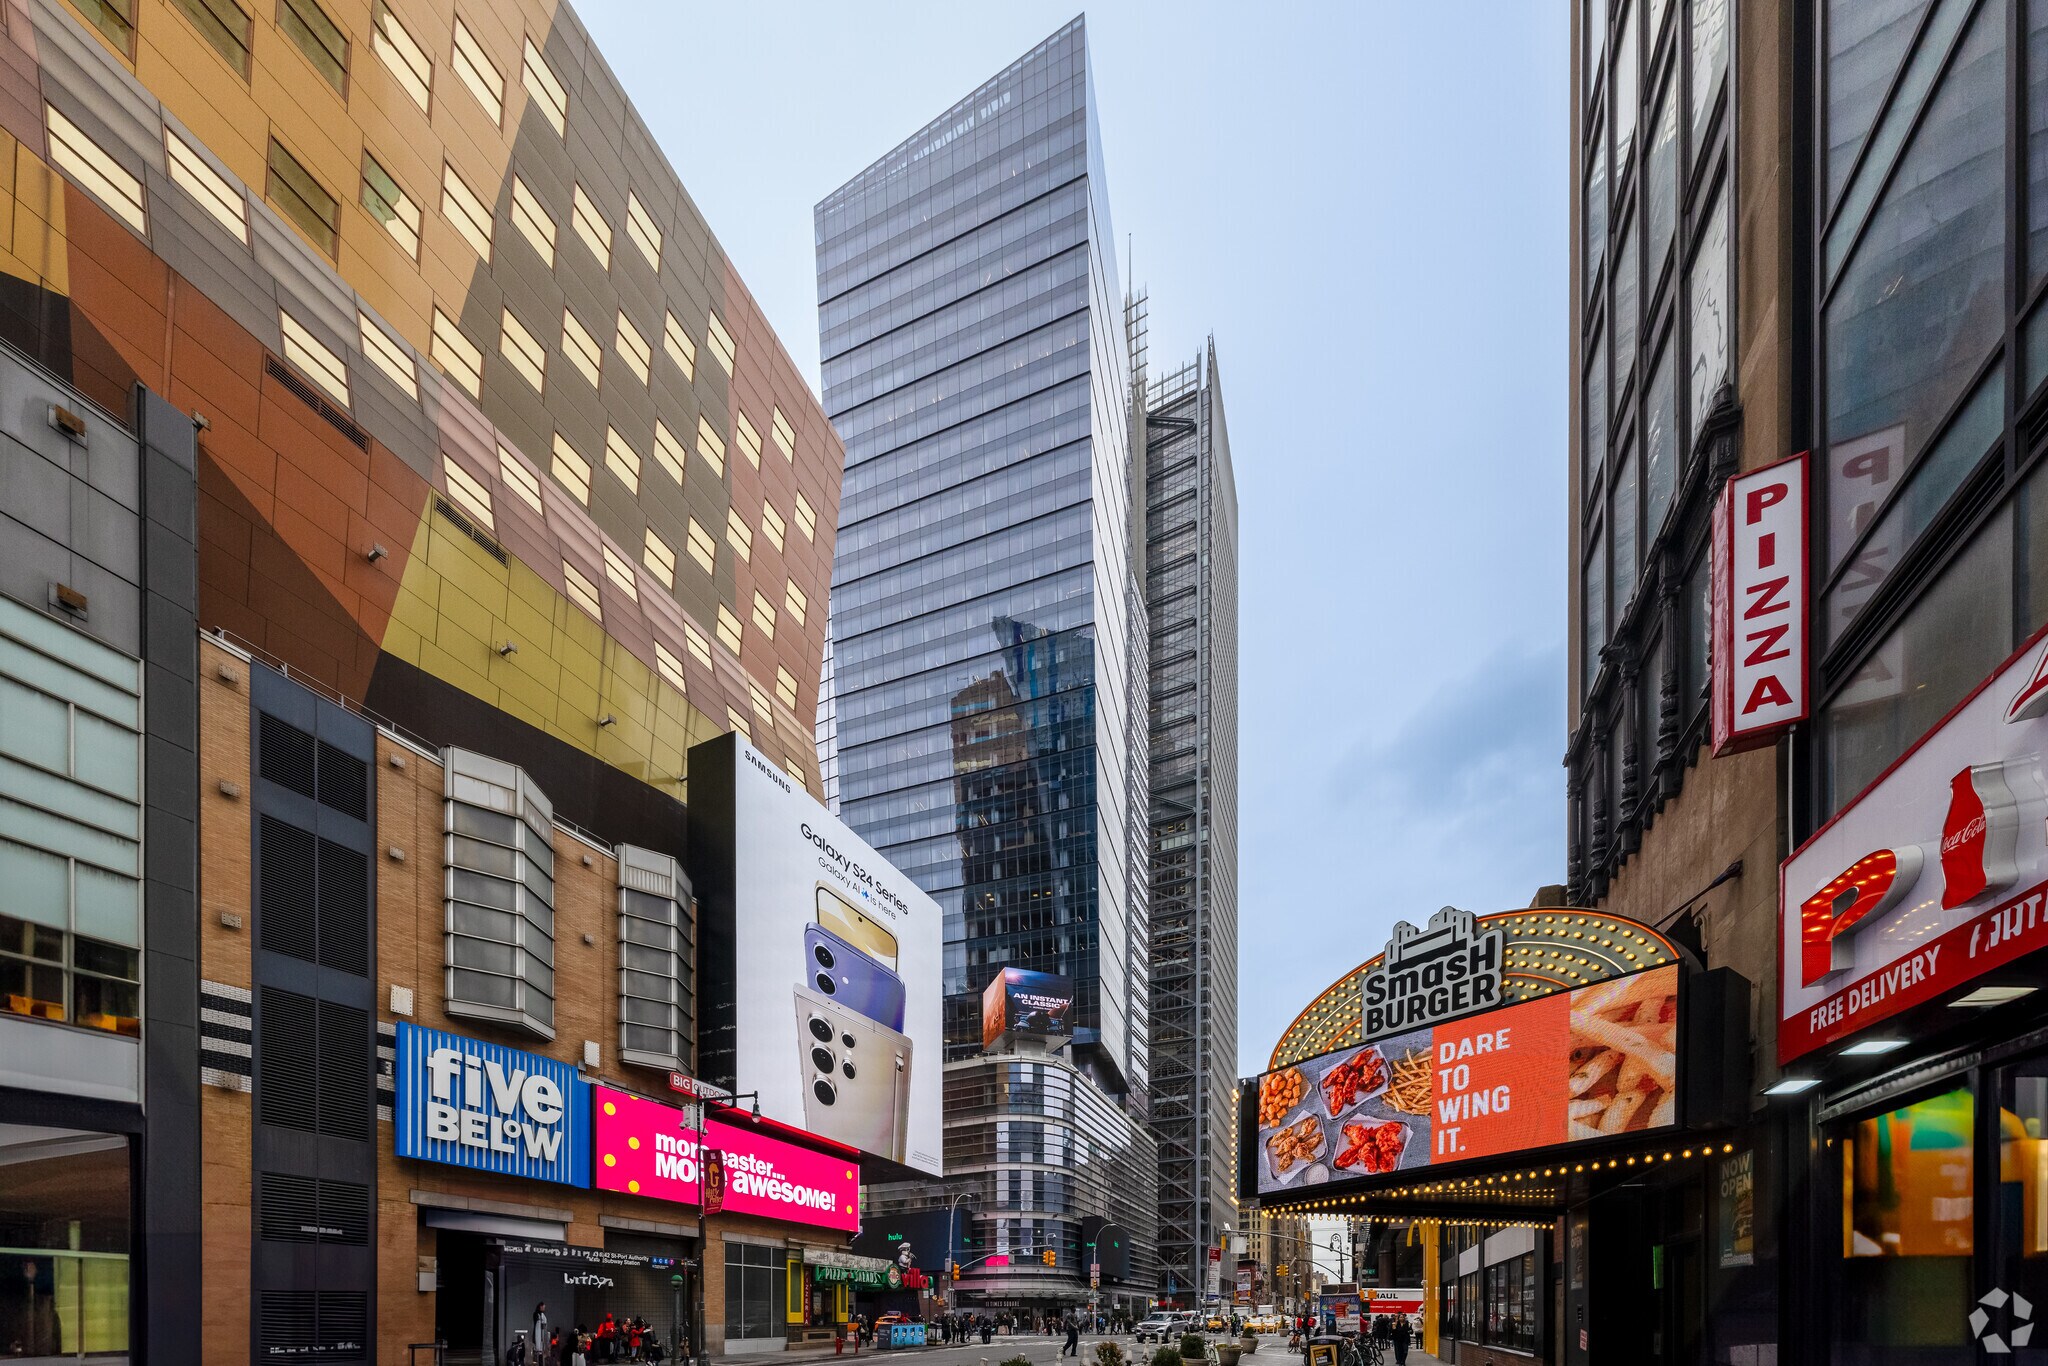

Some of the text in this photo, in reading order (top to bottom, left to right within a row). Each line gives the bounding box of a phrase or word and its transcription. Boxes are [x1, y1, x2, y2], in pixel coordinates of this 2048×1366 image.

[1741, 482, 1794, 715] PIZZA
[744, 749, 791, 794] SAMSUNG
[800, 822, 909, 916] Galaxy S24 Series
[817, 856, 851, 888] Galaxy
[870, 893, 877, 906] is
[878, 896, 897, 920] here
[1013, 992, 1070, 1005] AN INSTANT
[1021, 999, 1061, 1009] CLASSIC
[1366, 973, 1495, 1035] BURGER
[1809, 944, 1941, 1034] FREE DELIVERY
[1439, 1027, 1511, 1065] DARE
[426, 1048, 563, 1124] five
[673, 1074, 691, 1090] BIG
[1438, 1063, 1470, 1095] TO
[1438, 1085, 1511, 1125] WING
[1438, 1126, 1466, 1155] IT.
[1722, 1153, 1751, 1180] NOW
[1721, 1171, 1752, 1198] OPEN
[887, 1233, 903, 1241] hulu
[628, 1254, 650, 1263] Authority
[901, 1268, 929, 1289] villa
